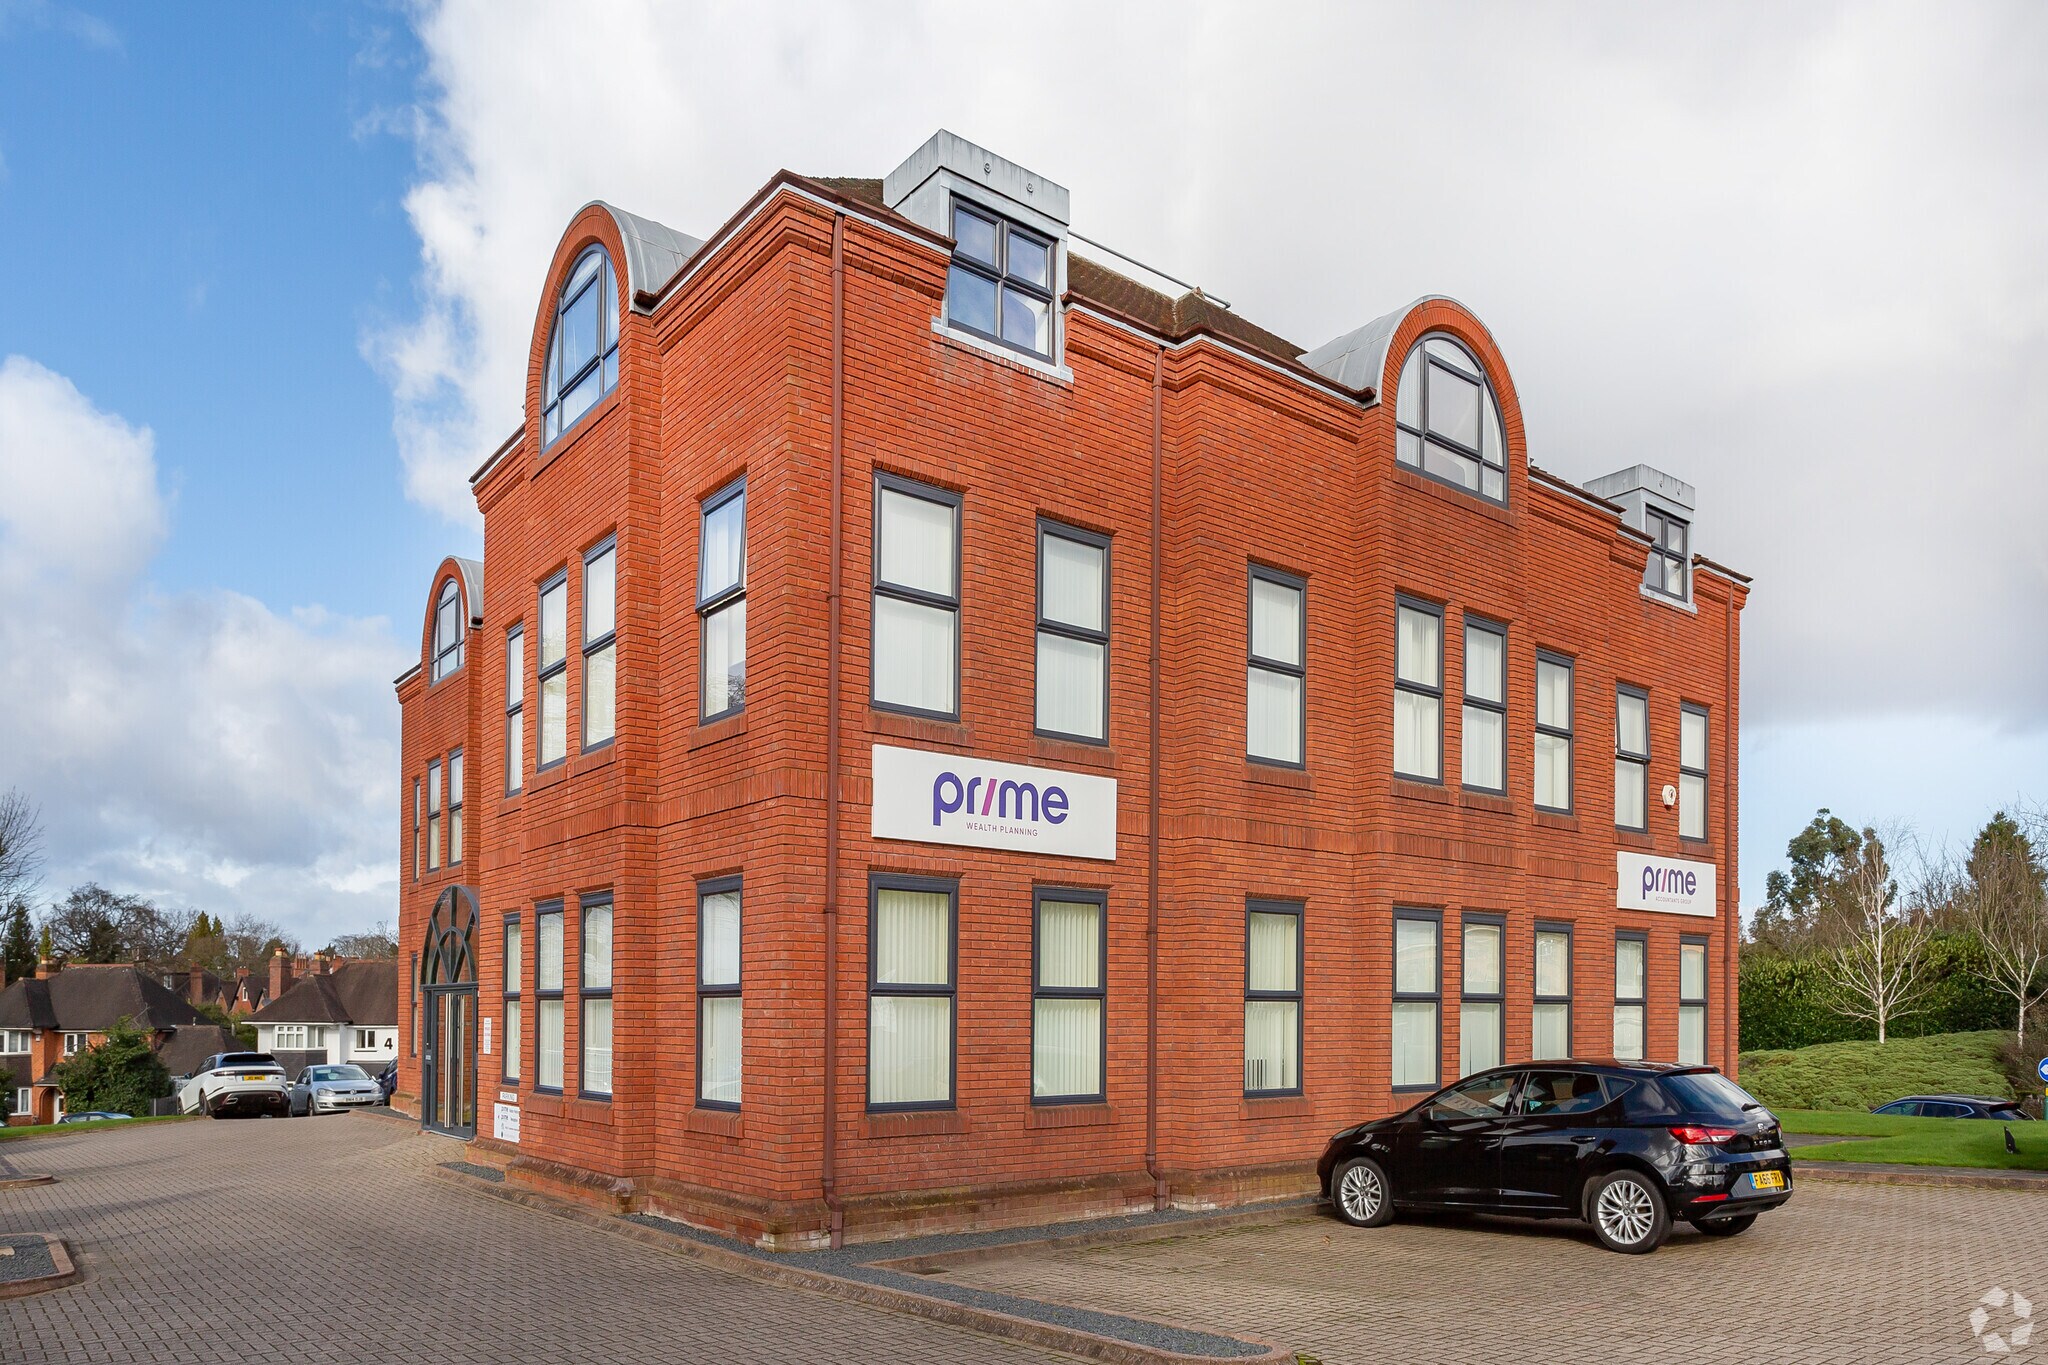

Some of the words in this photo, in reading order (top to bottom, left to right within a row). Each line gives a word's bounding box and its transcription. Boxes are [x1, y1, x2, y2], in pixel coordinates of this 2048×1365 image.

[965, 822, 998, 833] WEALTH
[999, 825, 1039, 837] PLANNING
[384, 1037, 393, 1050] 4
